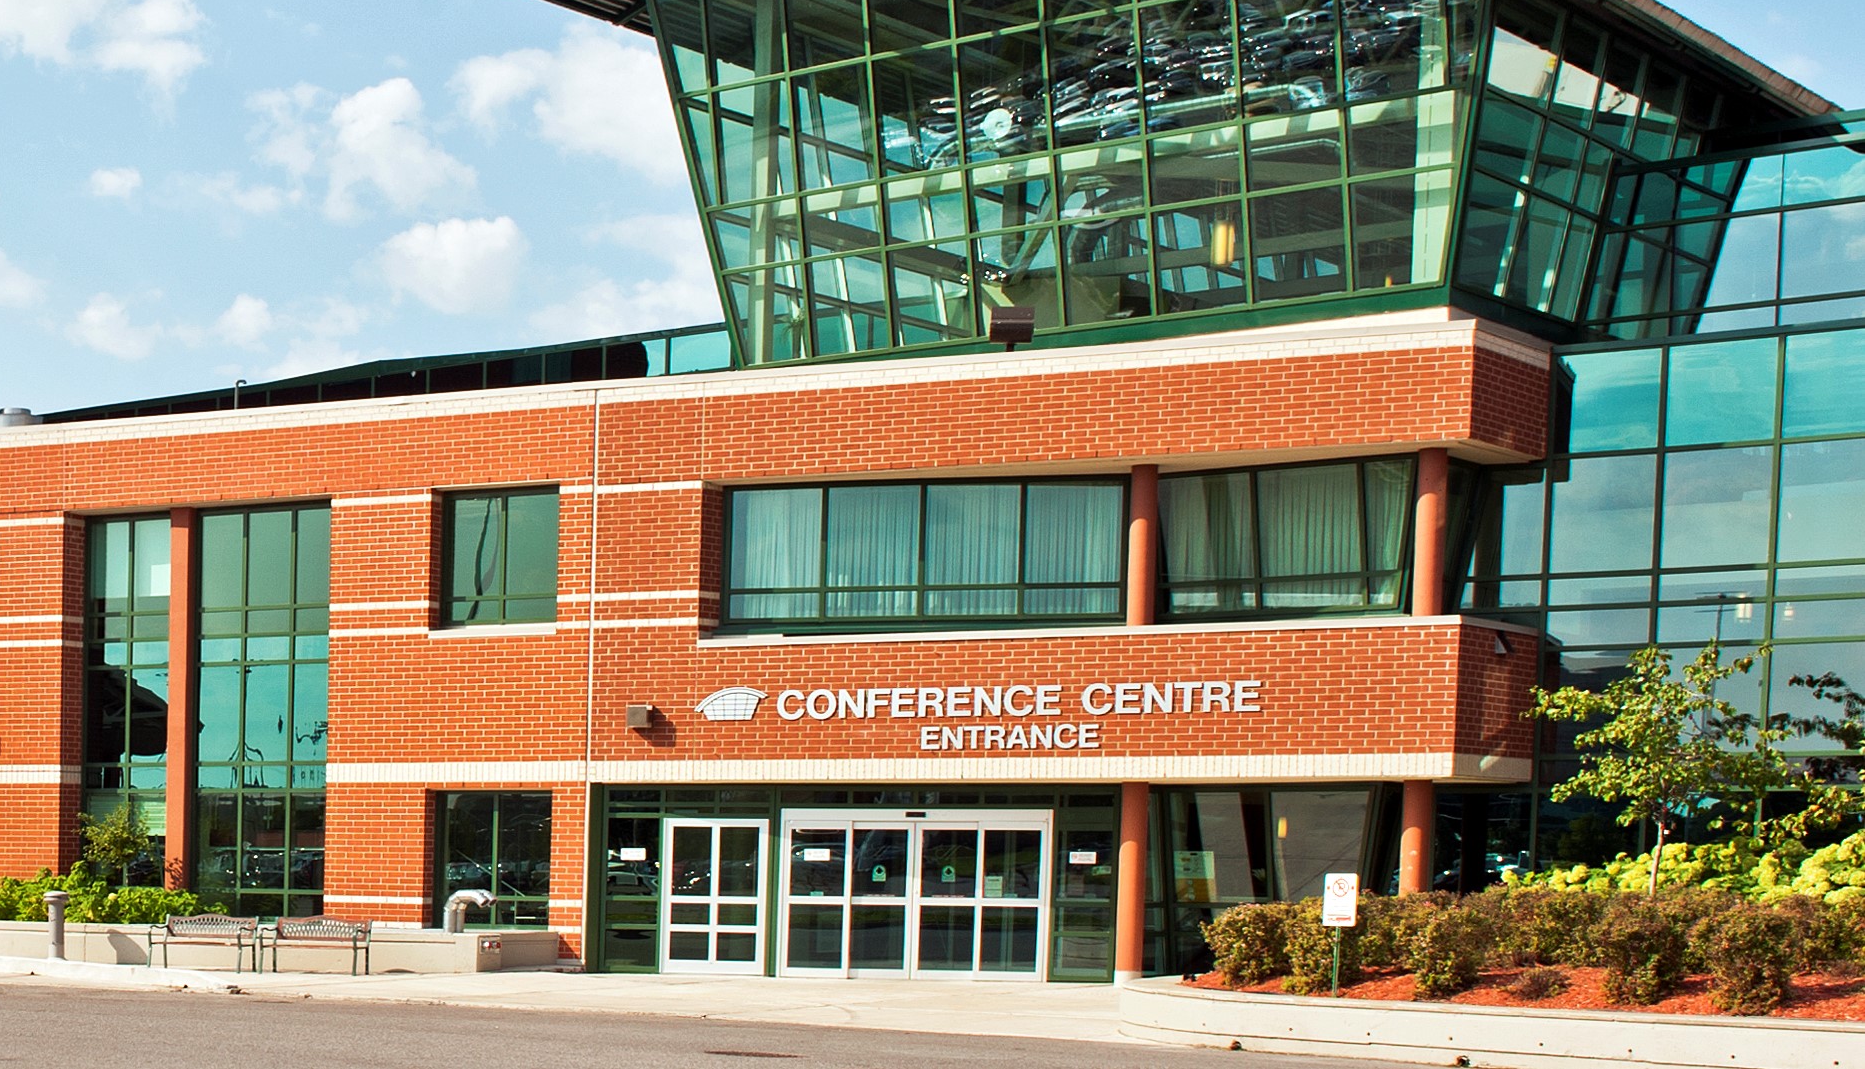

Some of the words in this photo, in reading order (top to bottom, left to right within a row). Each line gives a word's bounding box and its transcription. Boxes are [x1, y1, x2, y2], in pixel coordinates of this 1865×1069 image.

[776, 683, 1063, 721] CONFERENCE
[1080, 680, 1263, 715] CENTRE
[920, 723, 1101, 750] ENTRANCE
